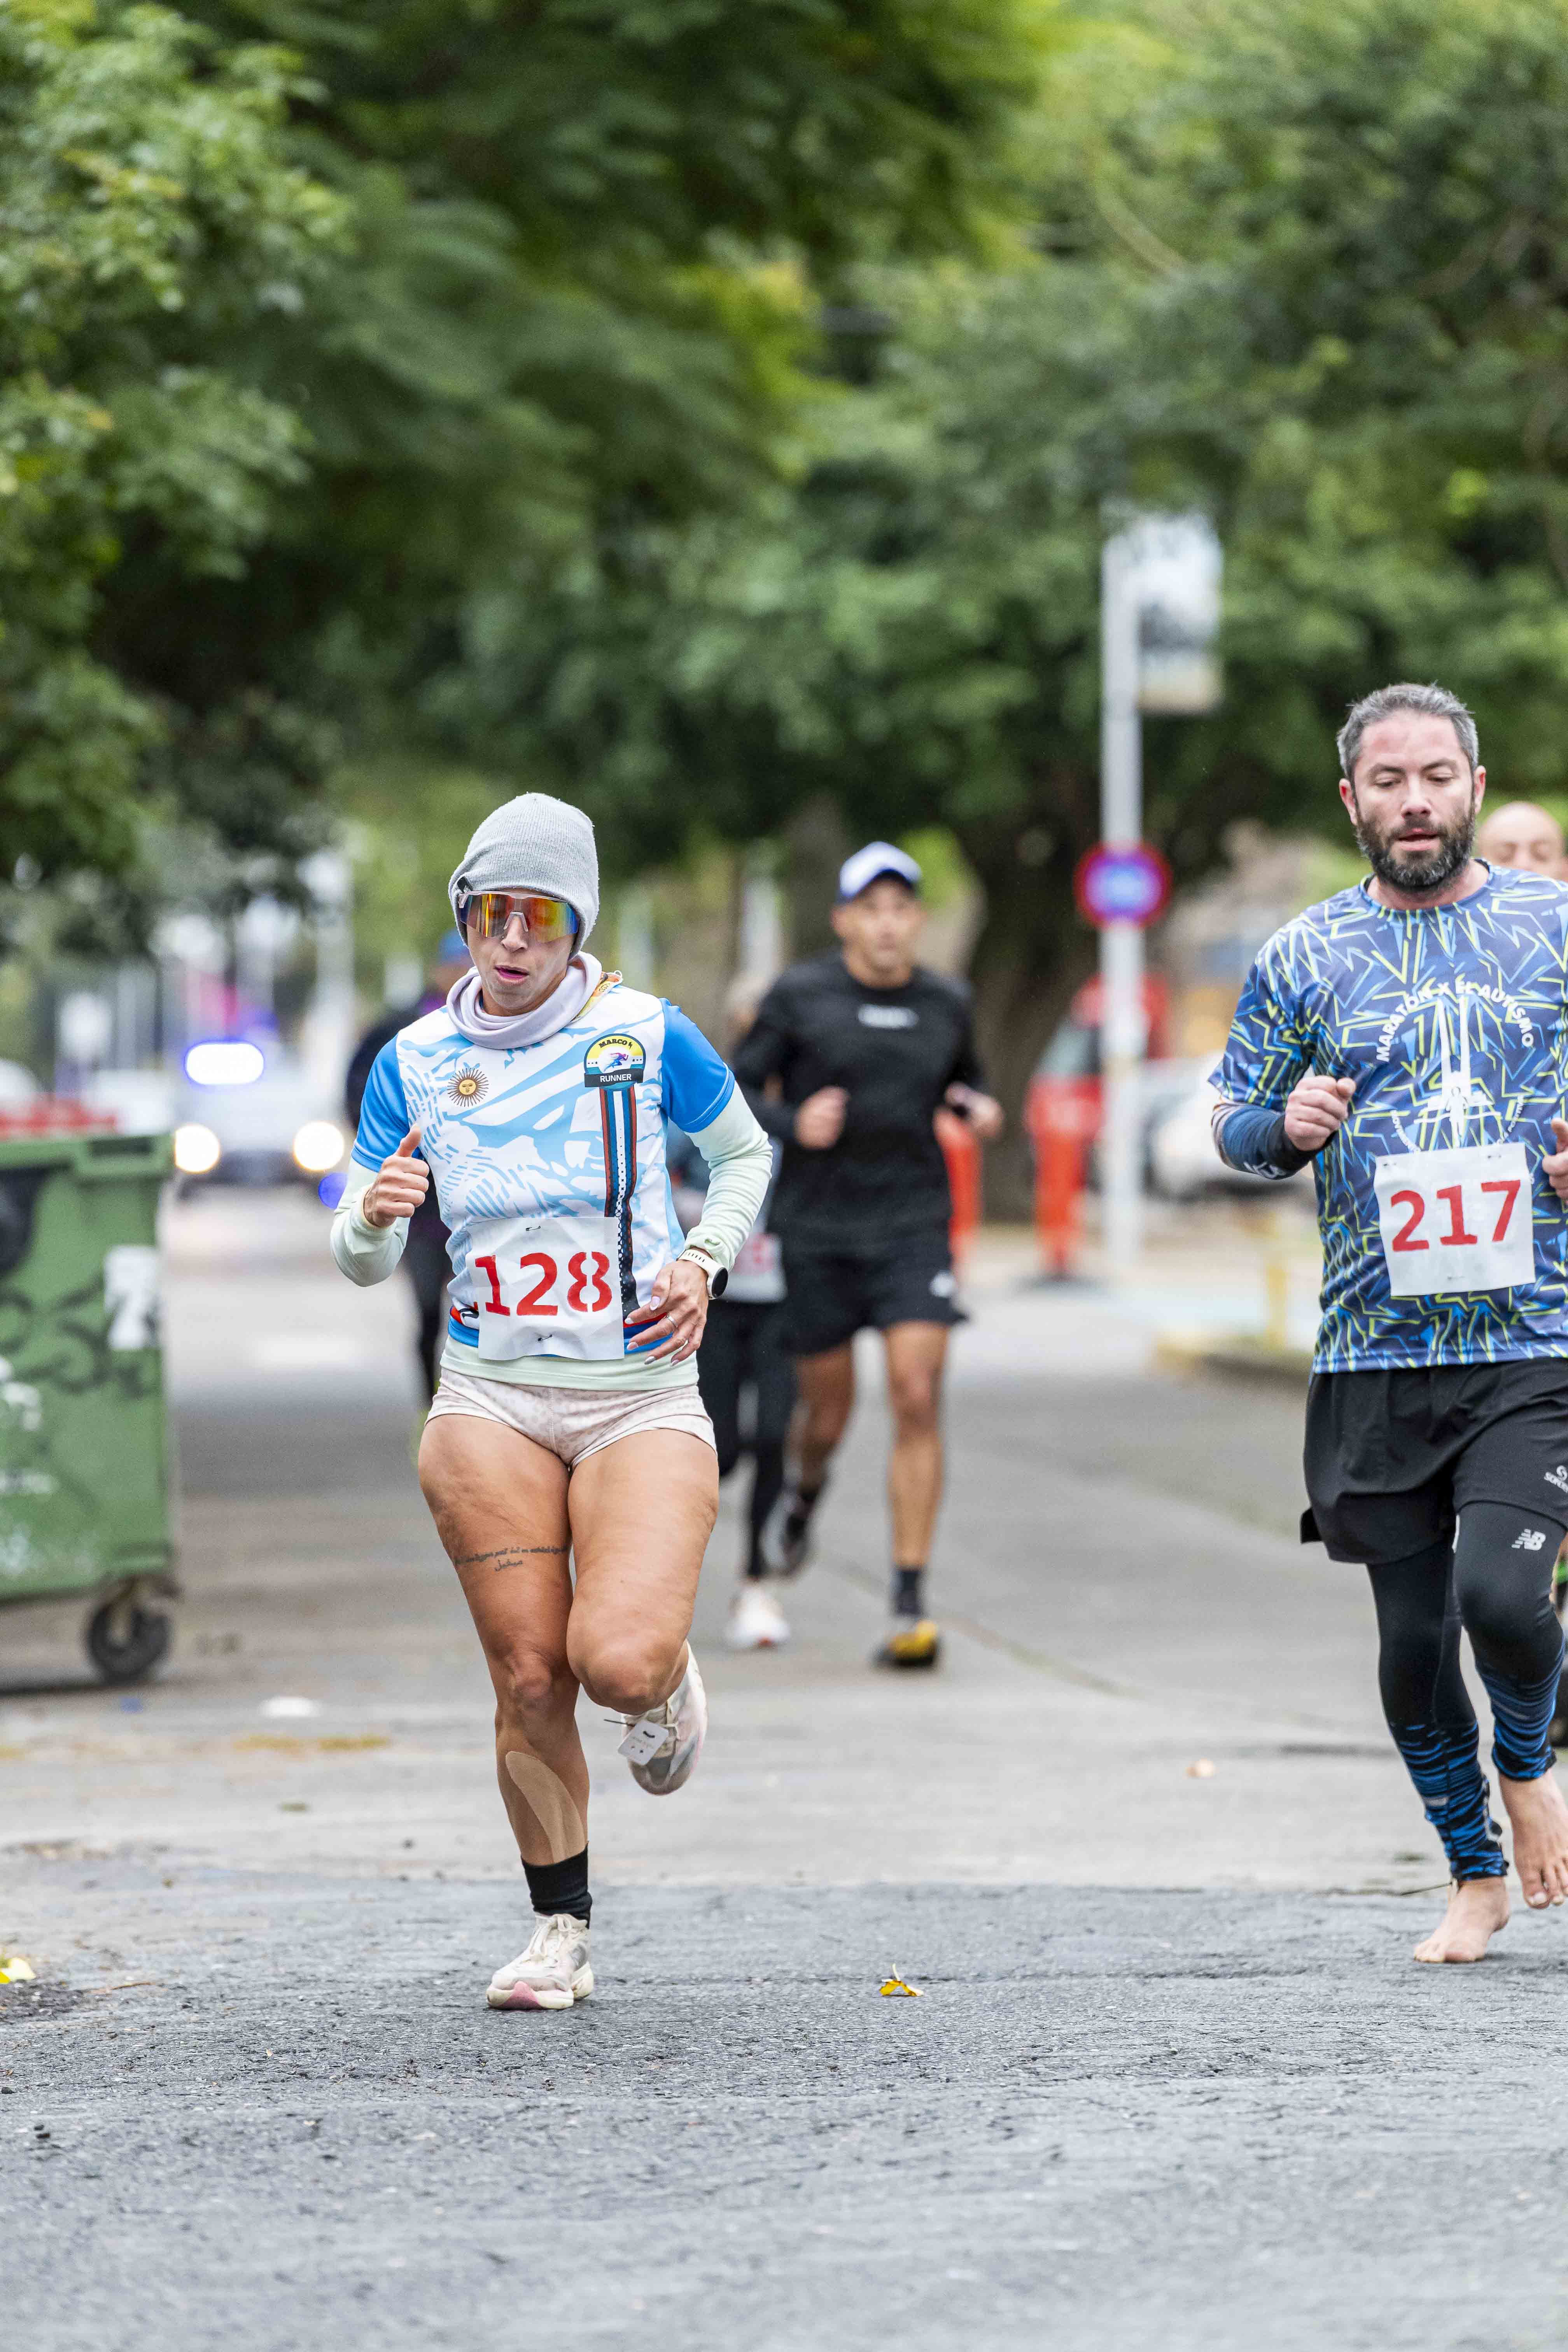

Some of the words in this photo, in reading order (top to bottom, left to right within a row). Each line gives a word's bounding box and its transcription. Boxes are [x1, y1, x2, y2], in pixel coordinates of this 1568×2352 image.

[1478, 984, 1534, 1047] AUTISMO
[600, 1073, 632, 1083] RUNNER
[1391, 1179, 1521, 1251] 217
[475, 1251, 612, 1316] 128
